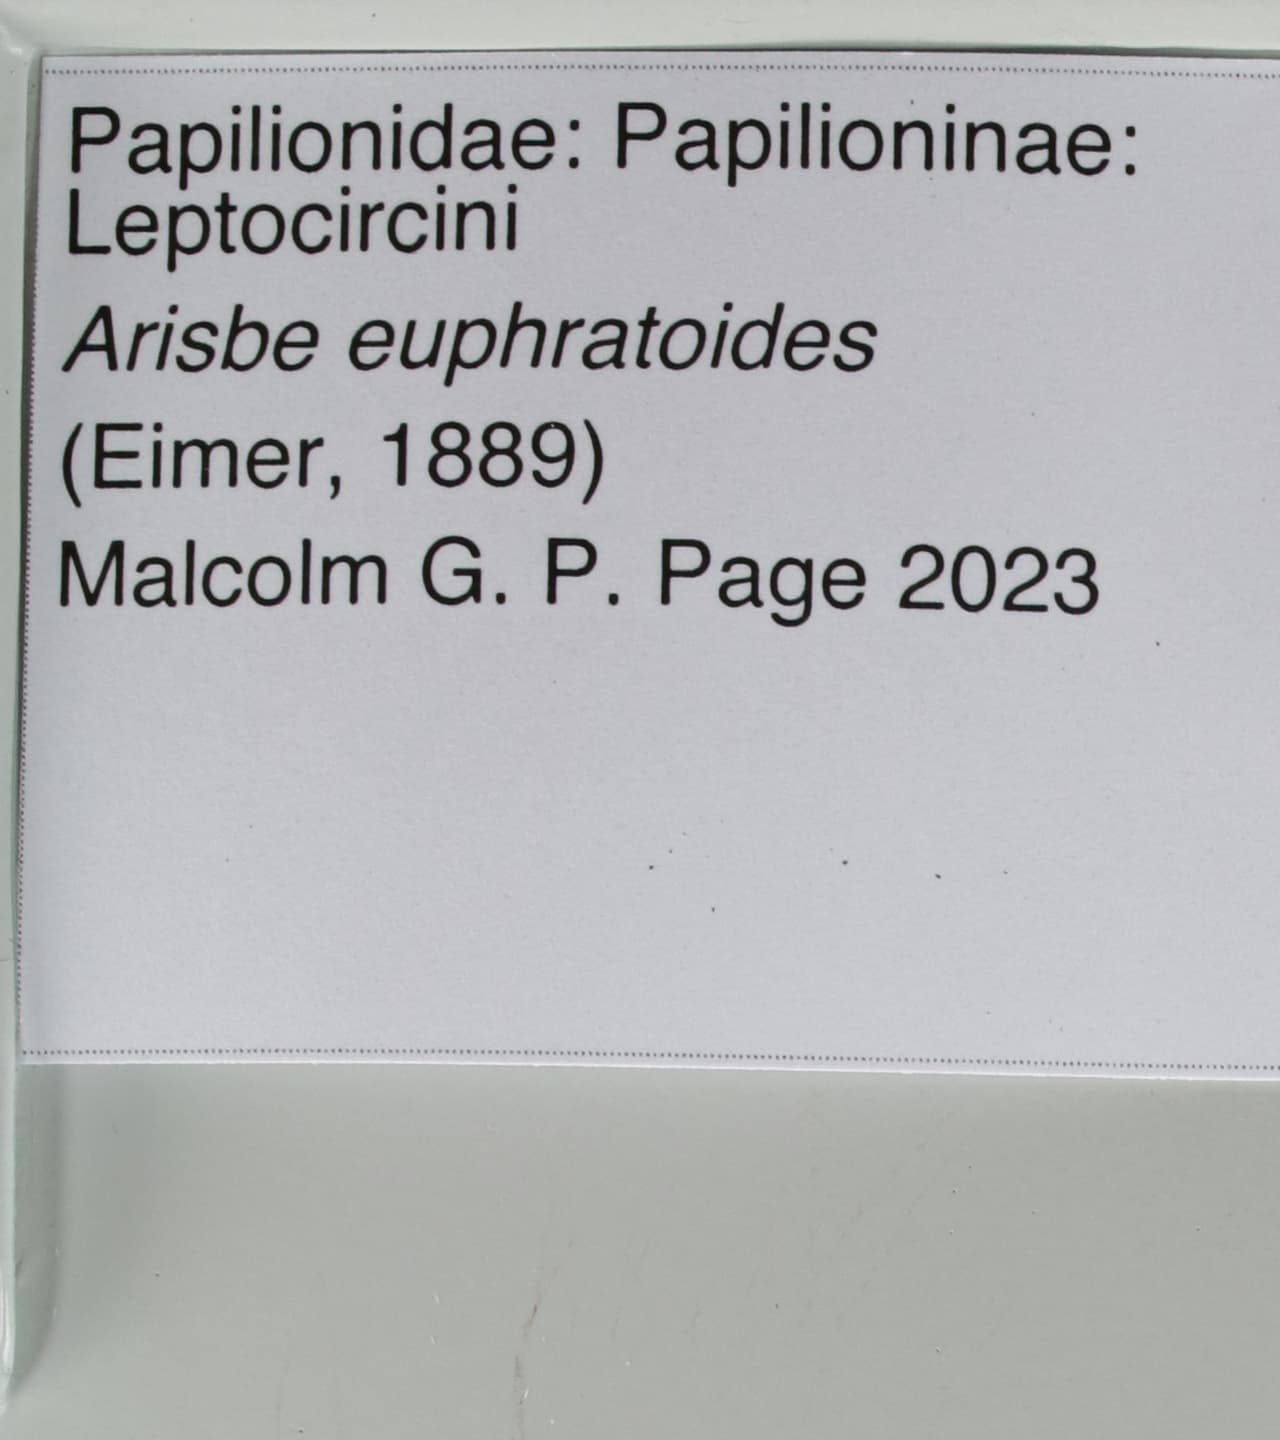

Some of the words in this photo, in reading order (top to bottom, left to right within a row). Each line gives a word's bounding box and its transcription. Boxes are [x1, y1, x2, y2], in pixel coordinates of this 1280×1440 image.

[71, 103, 580, 185] Papilionidae:
[617, 102, 1135, 187] Papilioninae:
[68, 184, 517, 272] Leptocircini
[61, 304, 319, 373] Arisbe
[349, 301, 877, 387] euphratoides
[62, 422, 340, 506] (Eimer,
[383, 419, 603, 505] 1889)
[60, 538, 387, 608] Malcolm
[422, 535, 506, 606] G.
[547, 537, 619, 606] P.
[661, 539, 866, 627] Page
[899, 544, 1099, 615] 2023
